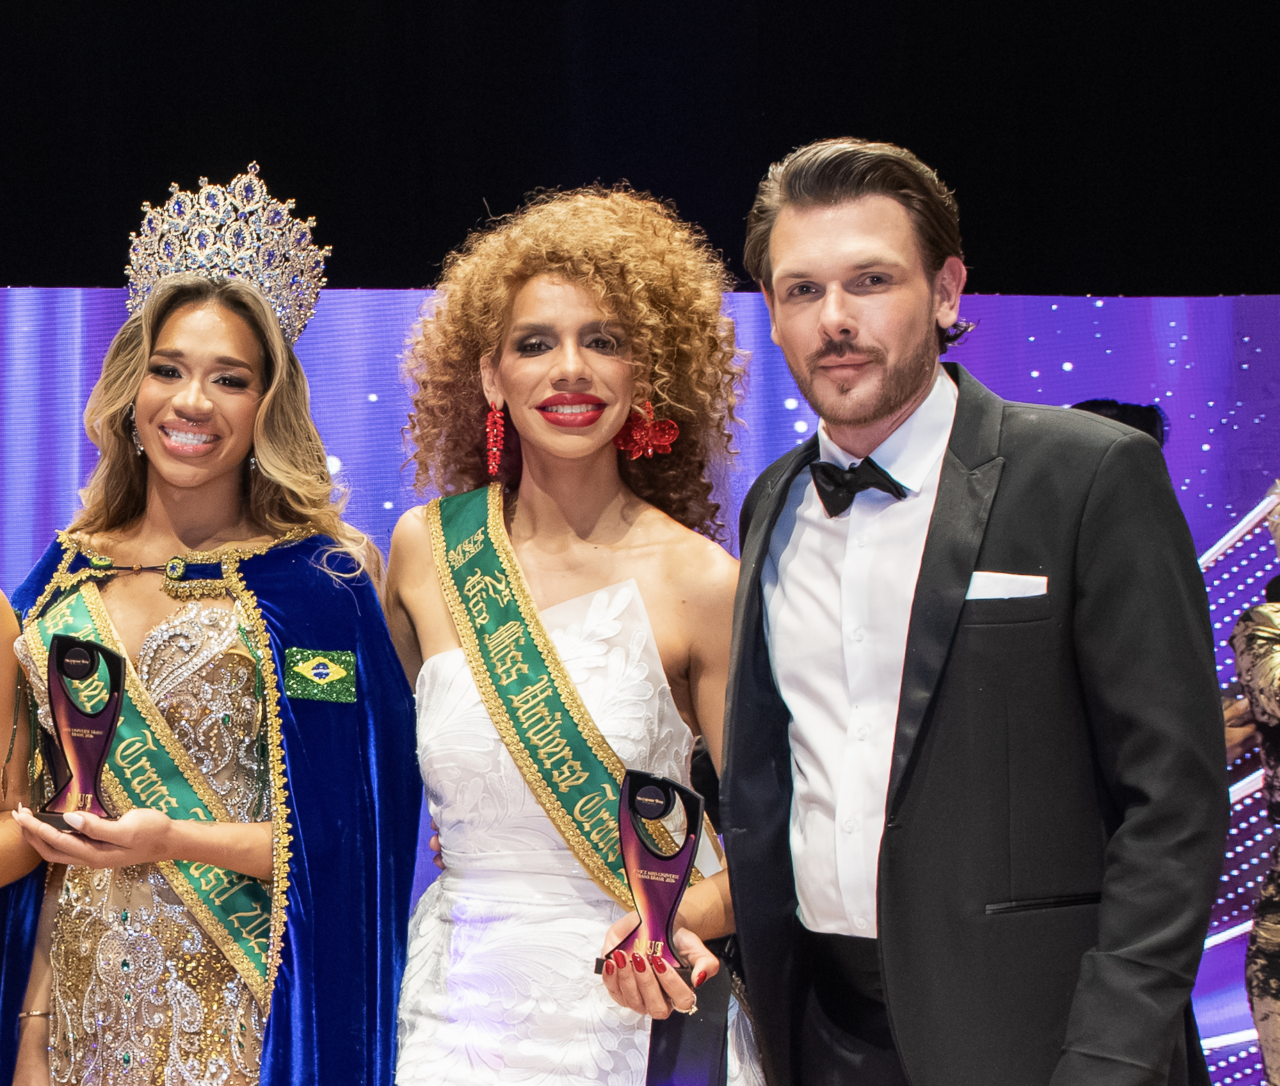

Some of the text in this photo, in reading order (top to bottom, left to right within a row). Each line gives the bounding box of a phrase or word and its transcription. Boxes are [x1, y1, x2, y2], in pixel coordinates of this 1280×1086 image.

[463, 568, 490, 629] Vice
[483, 621, 529, 686] Miss
[507, 674, 590, 793] Universe
[115, 729, 179, 814] Trans
